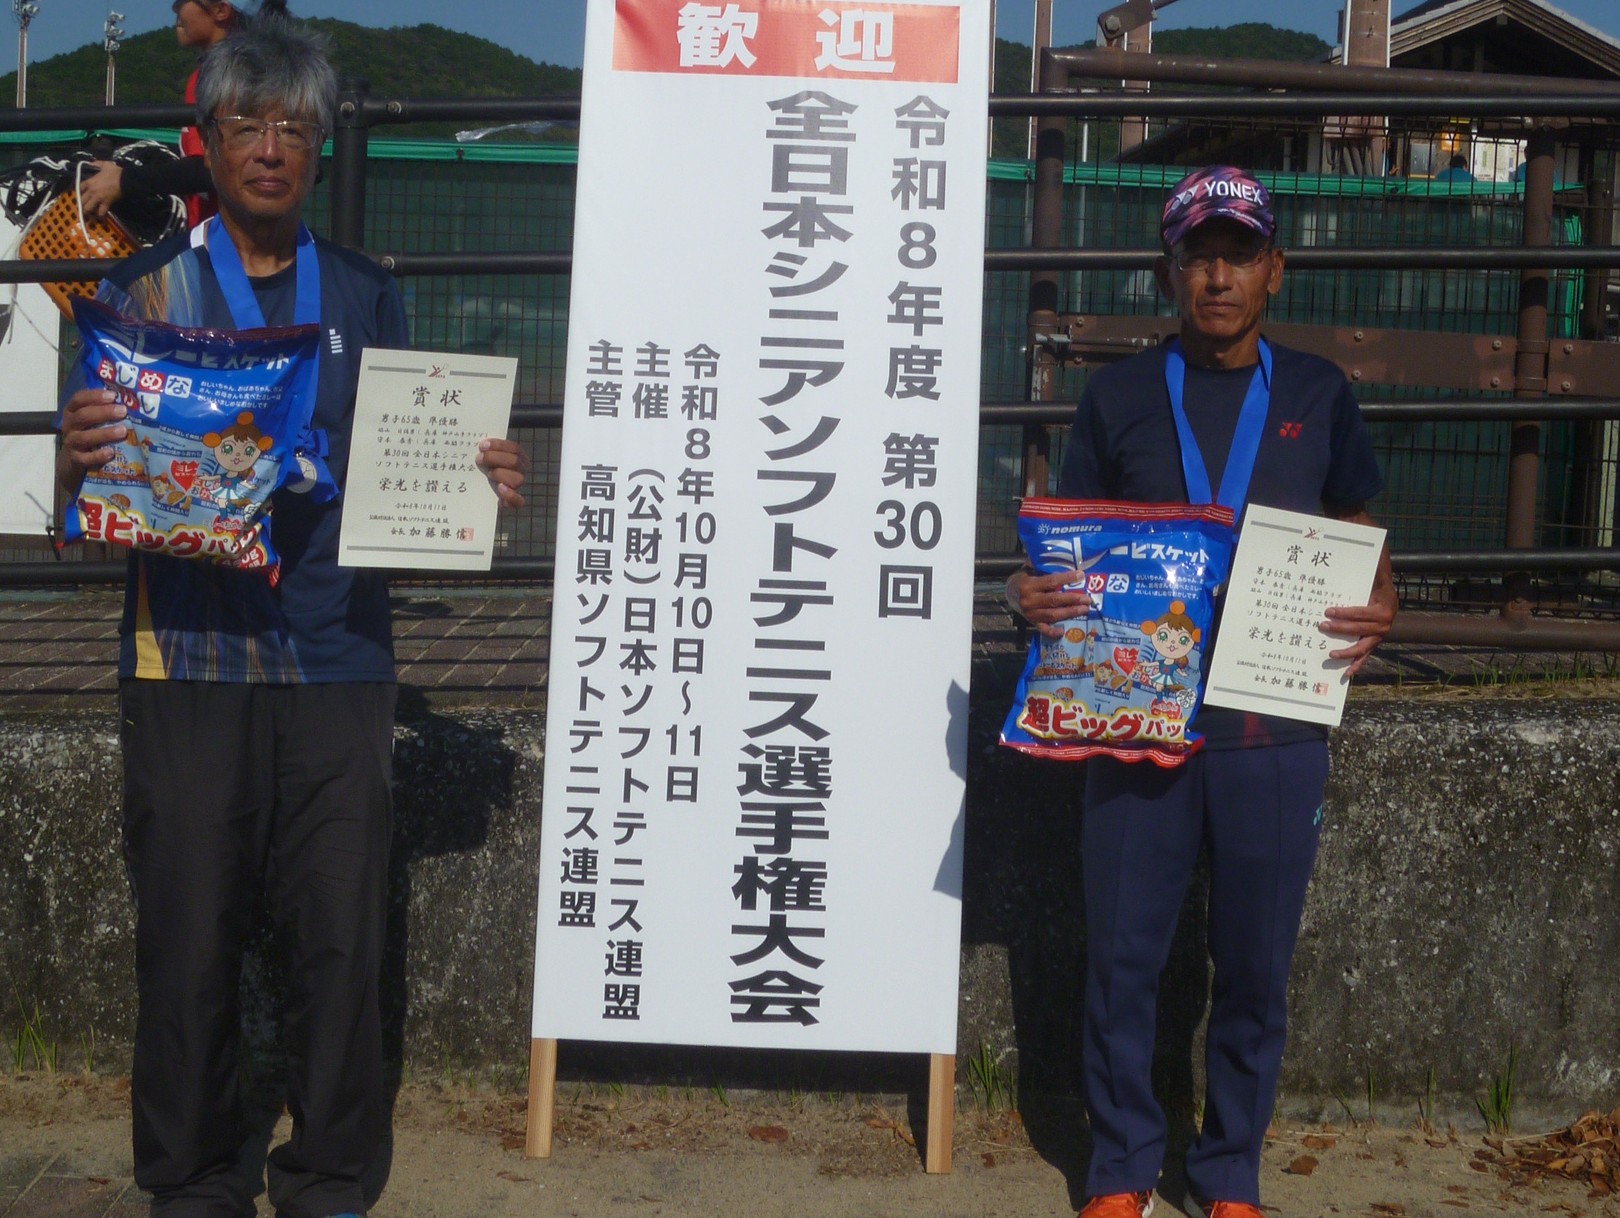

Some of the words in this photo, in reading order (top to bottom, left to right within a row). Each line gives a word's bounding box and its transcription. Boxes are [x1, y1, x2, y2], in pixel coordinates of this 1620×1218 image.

[676, 3, 896, 74] 歓迎
[1204, 181, 1263, 205] YONEX
[884, 95, 951, 401] 令和8年度
[98, 358, 189, 396] まじめな
[585, 339, 623, 419] 主管
[630, 341, 671, 420] 主催
[412, 385, 462, 407] 賞状
[375, 460, 476, 471] ソフトテニス選手権大会
[384, 449, 409, 458] 第30回
[413, 450, 468, 460] 全日本シニア
[379, 477, 467, 493] 栄光を讃える
[873, 432, 943, 620] 第30回
[1051, 524, 1102, 534] nomura
[727, 90, 859, 1026] 全日本シニアソフトテニス選手権大会
[1287, 545, 1332, 567] 賞状
[1249, 626, 1327, 650] 栄光を讃える
[557, 463, 618, 928] 高知県ソフトテニス連盟
